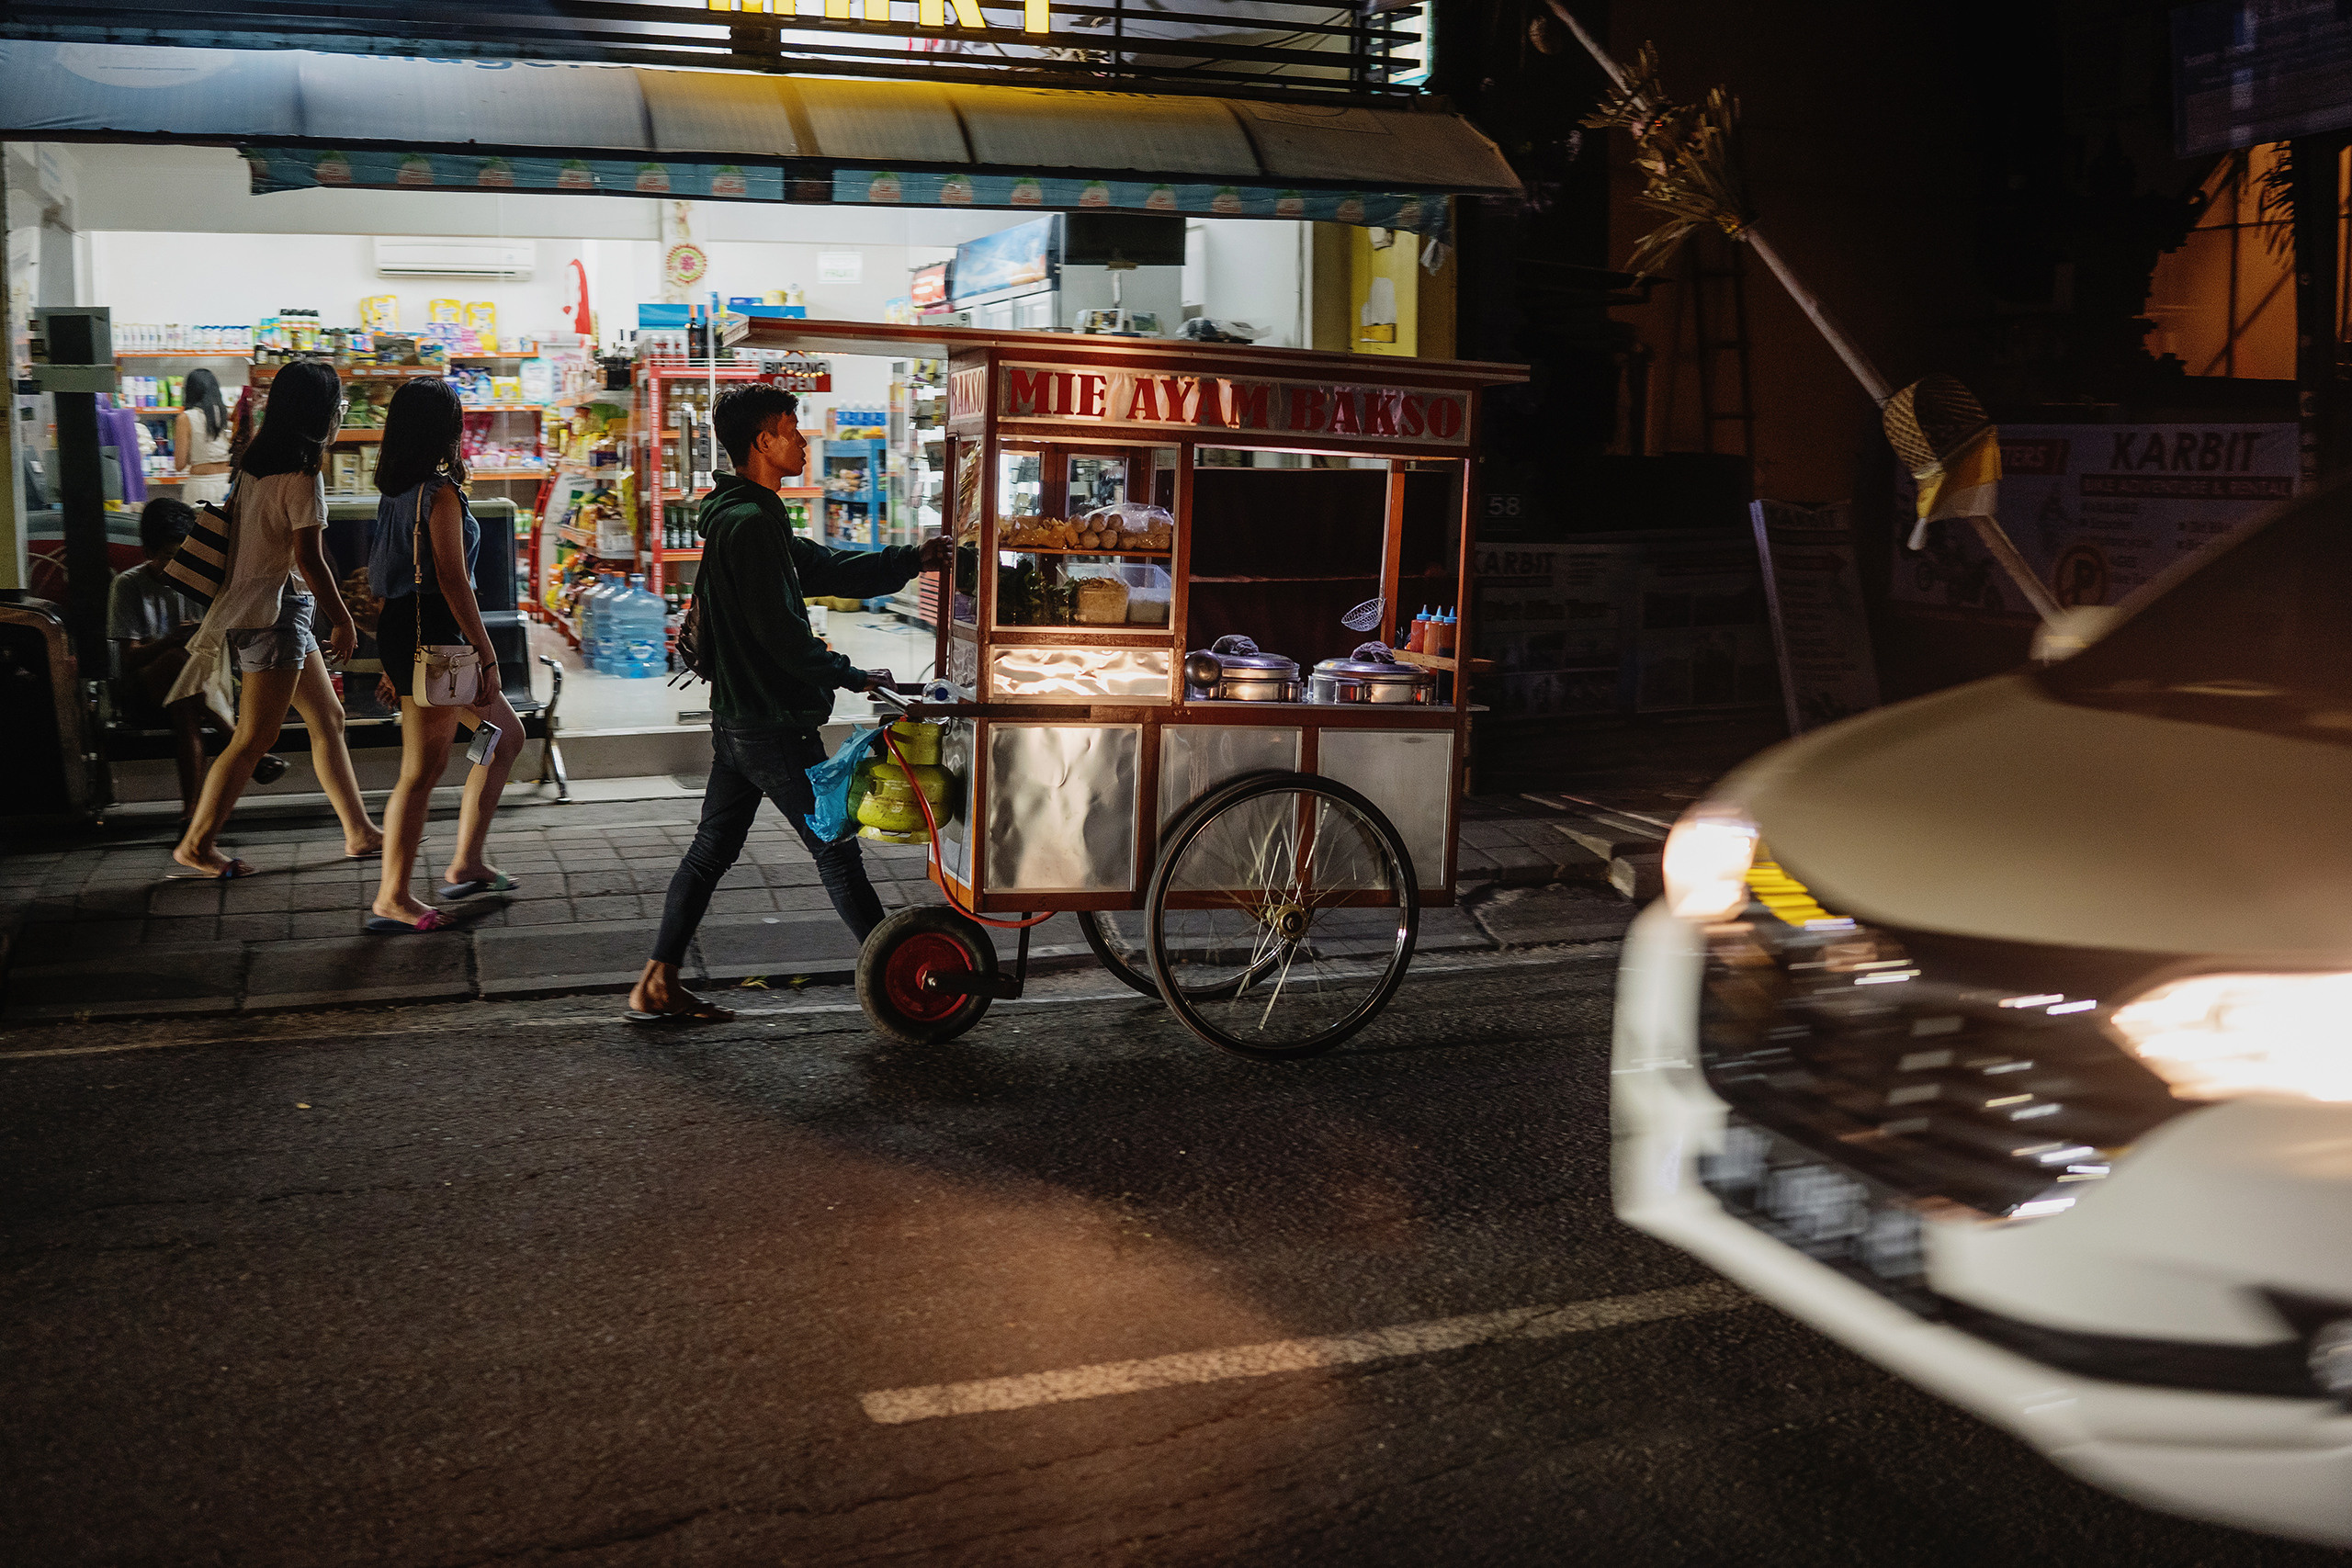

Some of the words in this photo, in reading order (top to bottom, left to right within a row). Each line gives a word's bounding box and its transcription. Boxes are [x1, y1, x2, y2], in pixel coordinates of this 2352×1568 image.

[764, 361, 827, 374] BINTANG
[773, 376, 817, 391] OPEN
[951, 369, 985, 416] BAKSO
[1008, 369, 1108, 417] MIE
[1125, 377, 1270, 429] AYAM
[1287, 388, 1463, 439] BAKSO
[2109, 431, 2264, 472] KARBIT
[1487, 496, 1521, 516] 58
